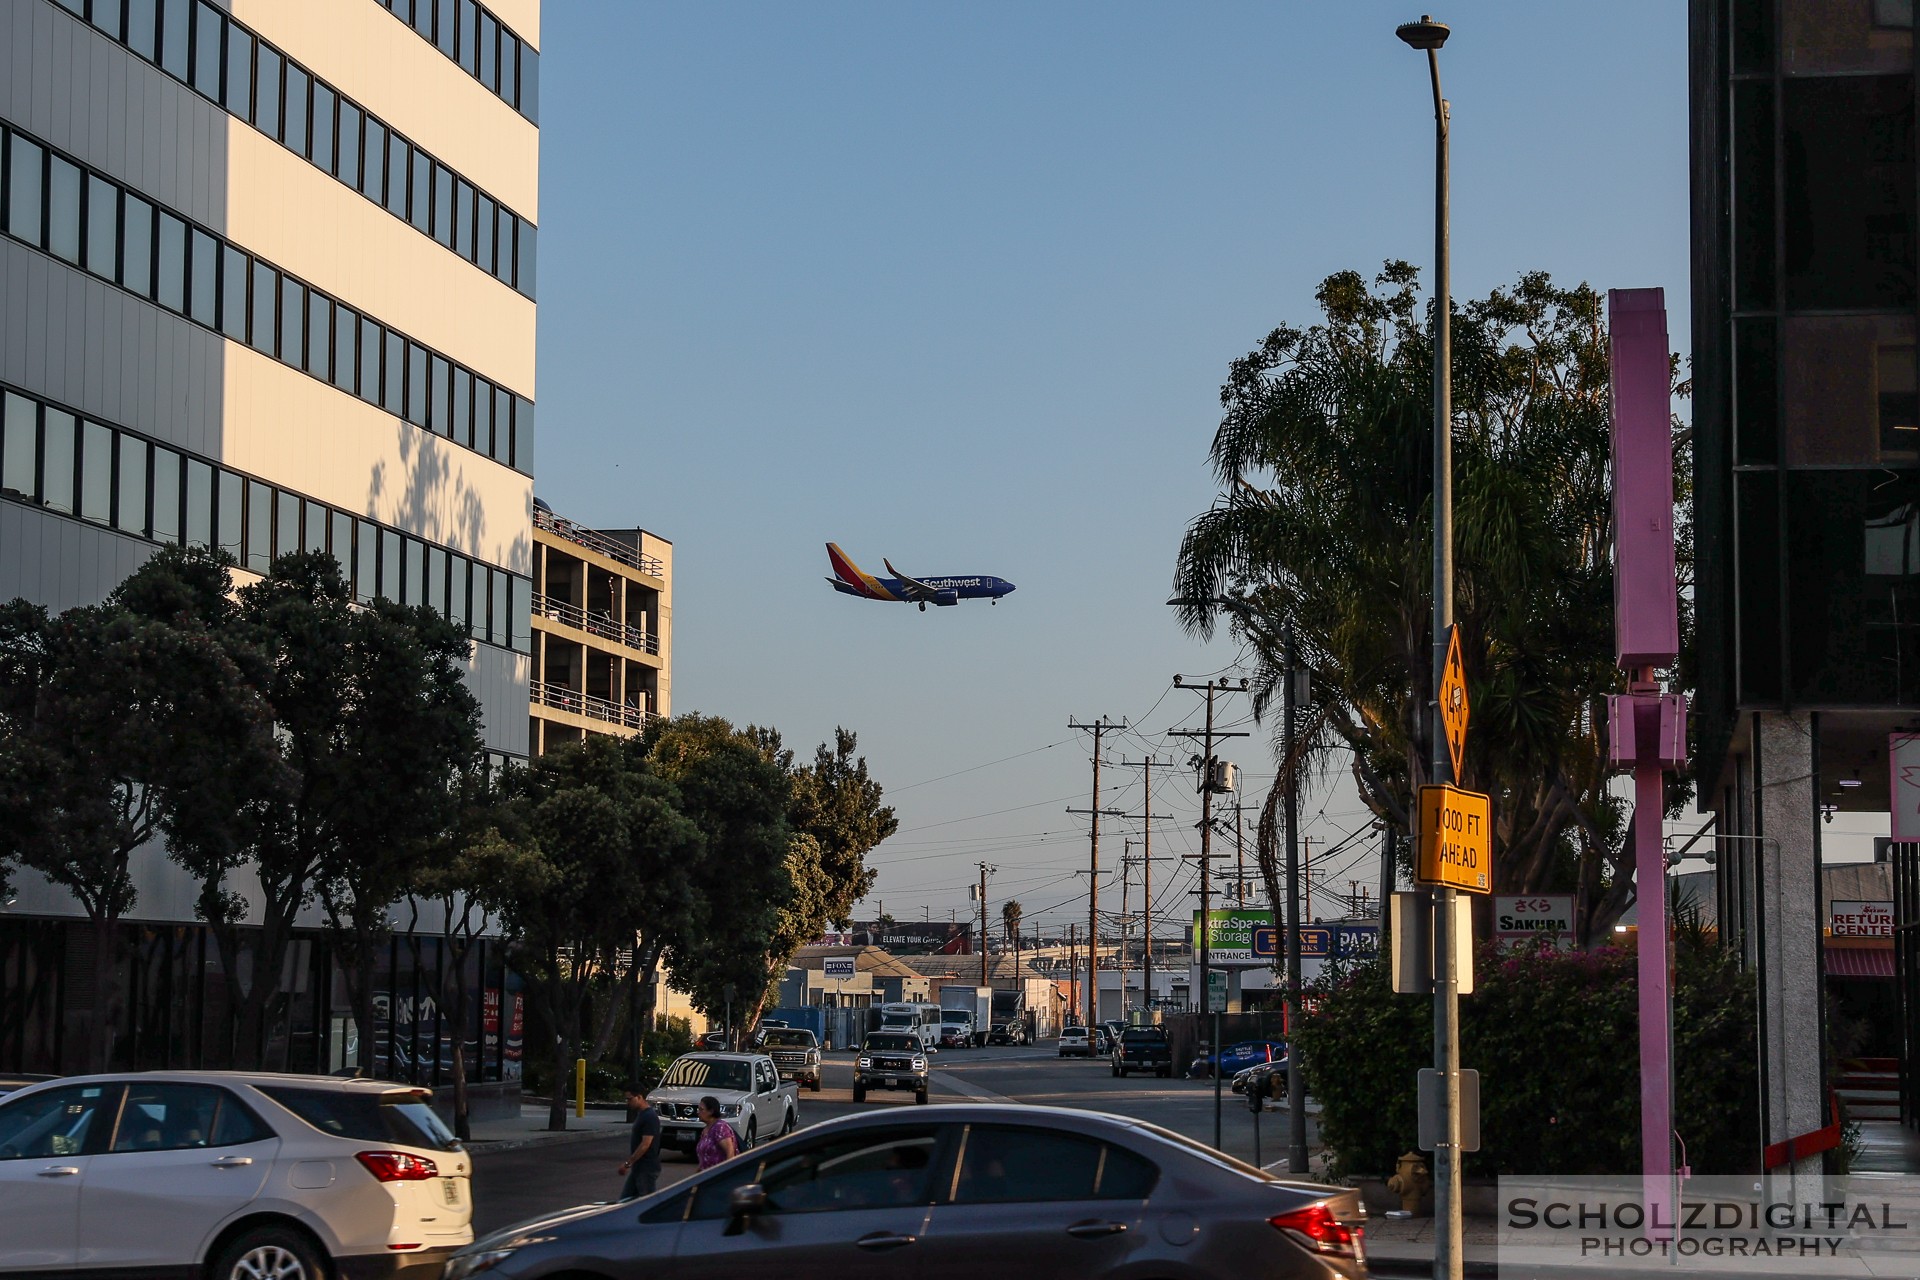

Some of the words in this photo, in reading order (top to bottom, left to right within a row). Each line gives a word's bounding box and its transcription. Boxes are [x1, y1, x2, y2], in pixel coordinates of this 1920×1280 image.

[923, 577, 981, 588] Southwest
[1435, 807, 1462, 832] 1000
[1467, 813, 1480, 836] FT
[1439, 841, 1477, 869] AHEAD
[1515, 898, 1551, 913] さくら
[882, 935, 906, 943] ELEVATE
[907, 935, 922, 943] YOUR
[1211, 929, 1252, 944] Storag
[1208, 952, 1251, 960] NTRANCE
[1209, 974, 1215, 983] 2
